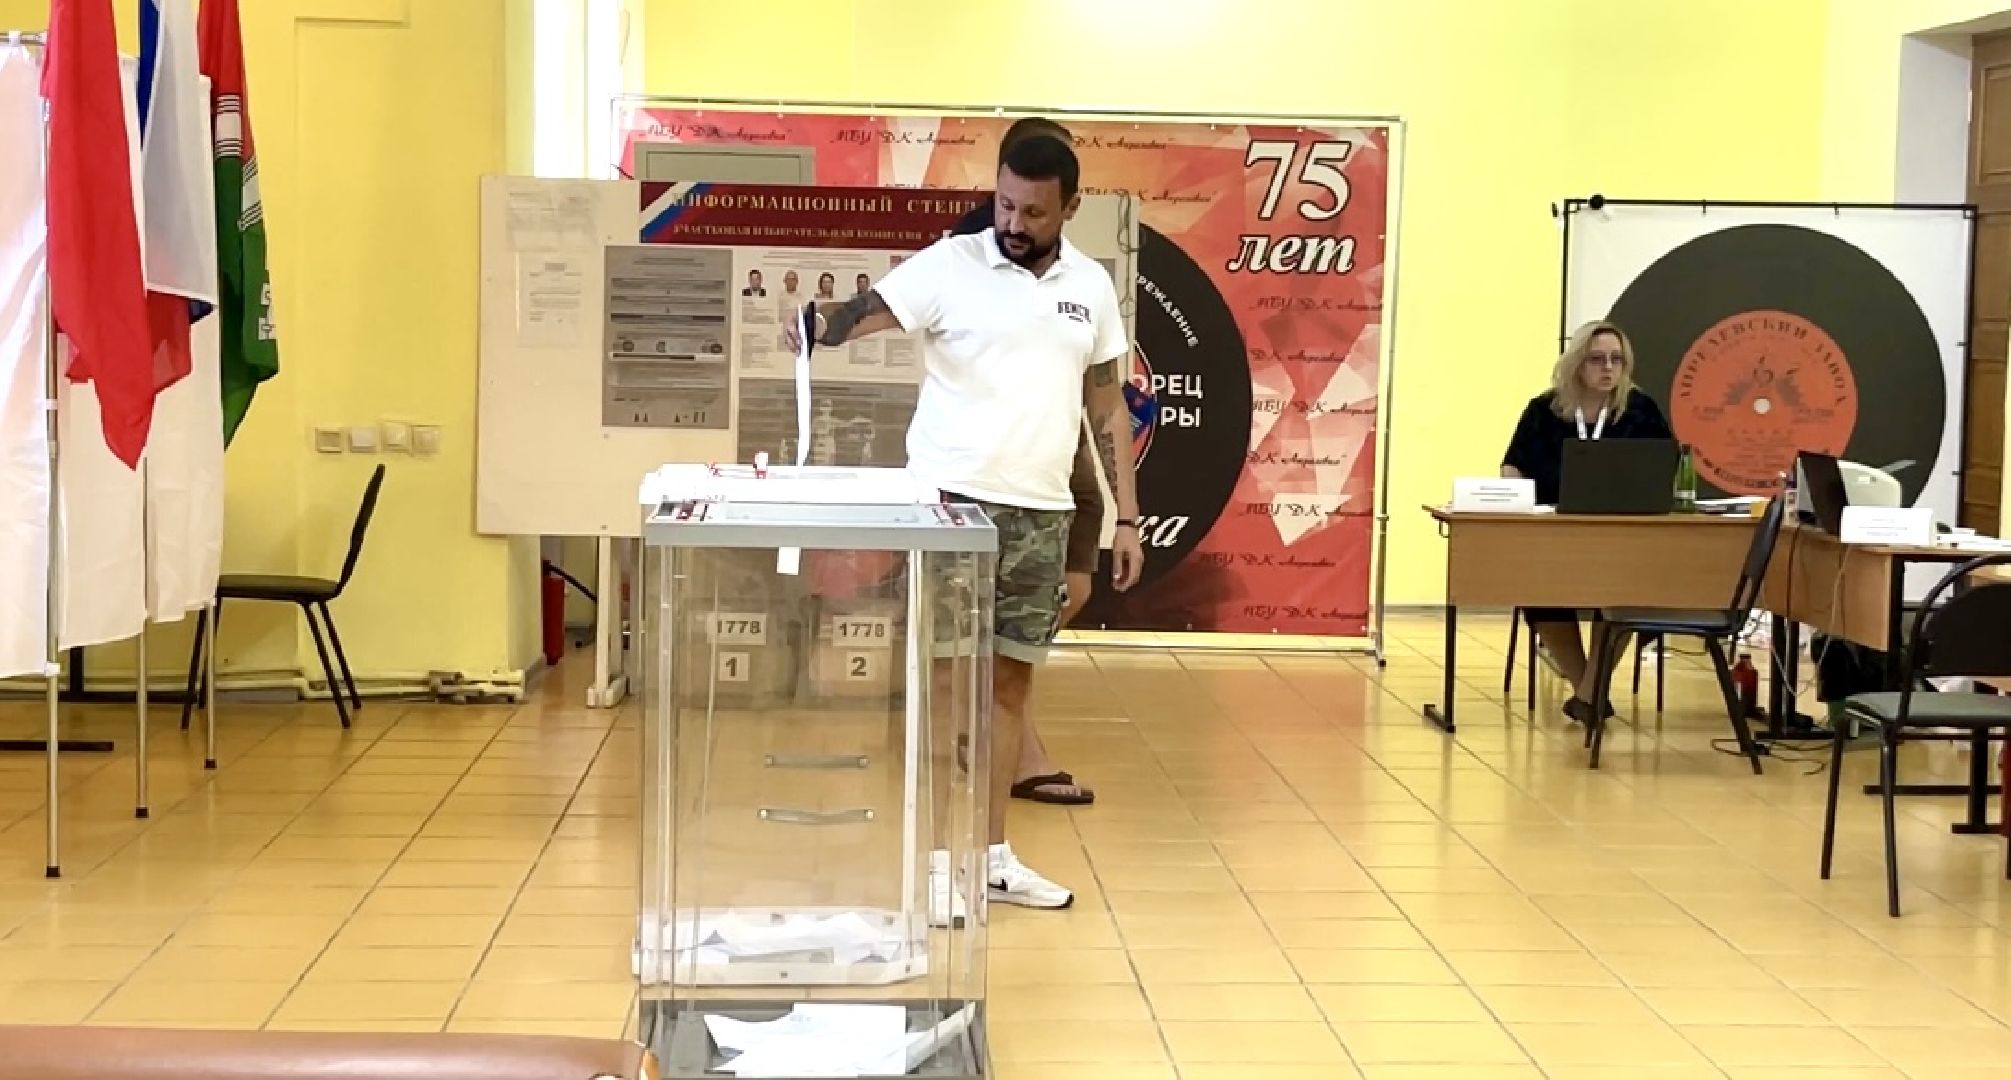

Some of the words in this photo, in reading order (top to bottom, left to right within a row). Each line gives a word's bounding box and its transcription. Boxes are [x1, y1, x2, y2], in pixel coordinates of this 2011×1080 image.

[1244, 139, 1352, 222] 75
[673, 193, 893, 215] ИНФОРМАЦИОННЫЙ
[1225, 234, 1357, 276] лет
[1137, 274, 1200, 347] РЕЖДЕНИЕ
[1133, 373, 1205, 401] ОРЕЦ
[1160, 405, 1202, 428] РЫ
[717, 620, 762, 634] 1778
[839, 621, 885, 638] 1778
[725, 656, 738, 678] 1
[850, 656, 867, 677] 2
